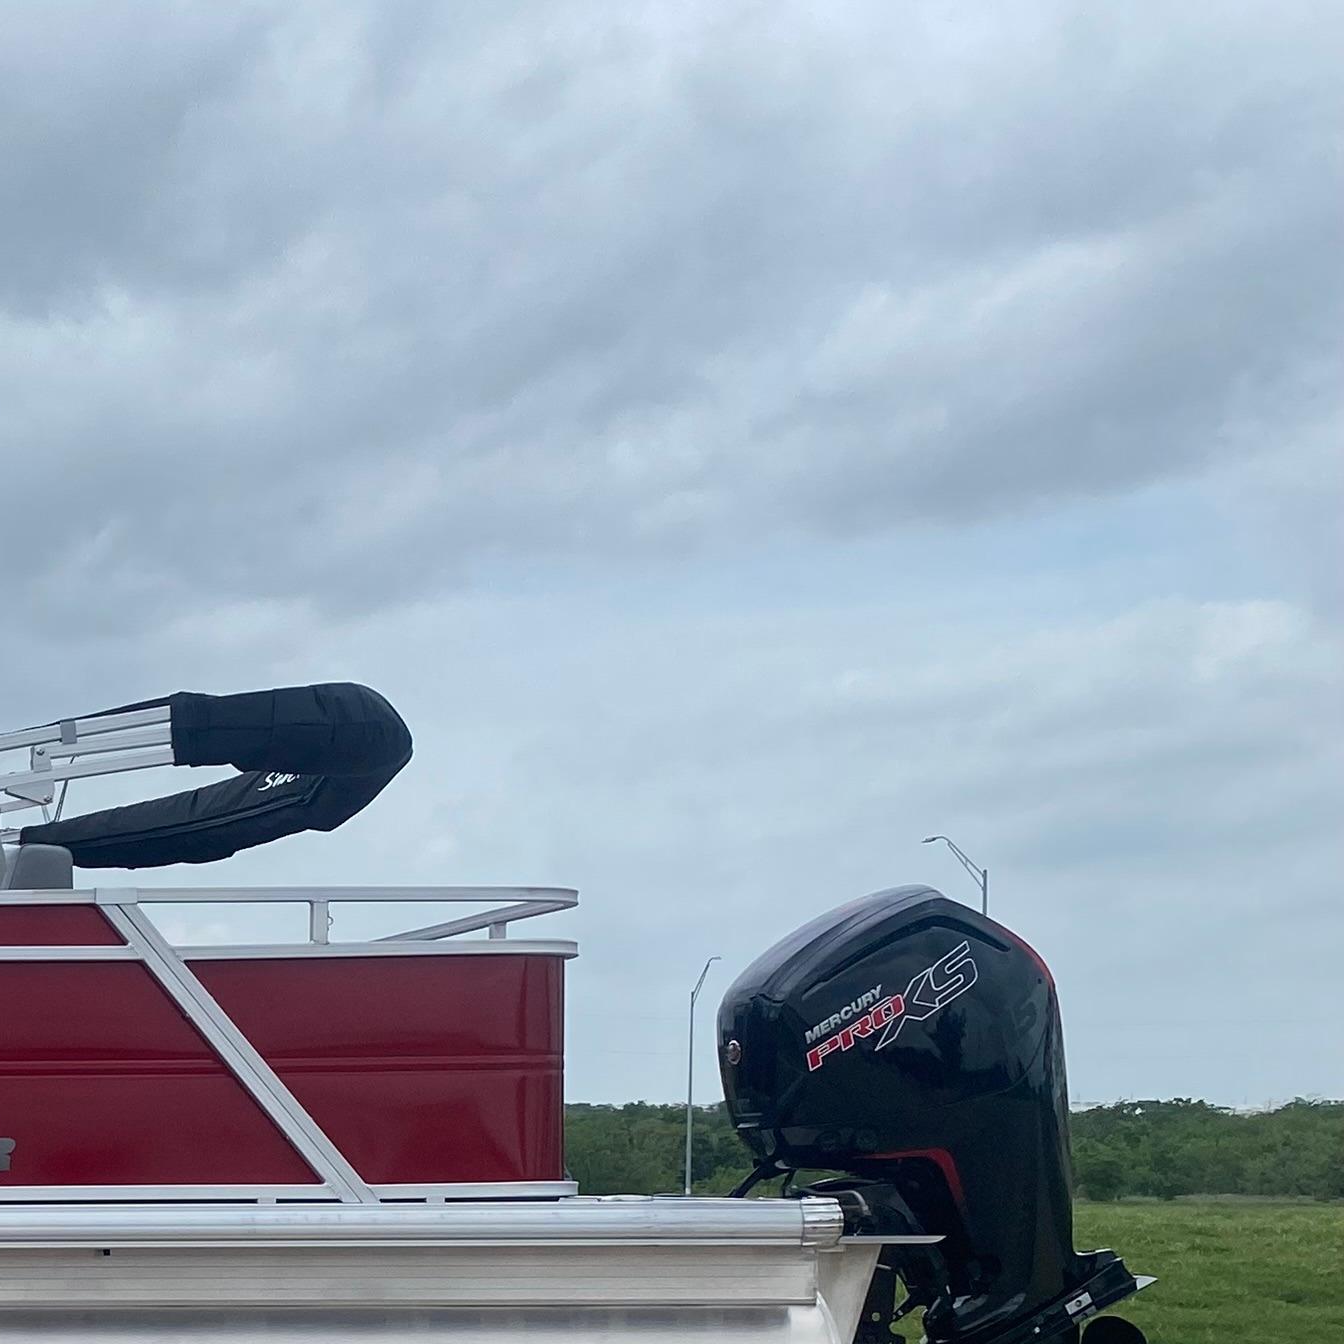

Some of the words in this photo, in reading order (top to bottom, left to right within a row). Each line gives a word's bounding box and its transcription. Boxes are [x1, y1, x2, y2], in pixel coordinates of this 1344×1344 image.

[805, 984, 883, 1044] MERCURY
[807, 994, 905, 1072] PRO
[874, 940, 979, 1051] XS
